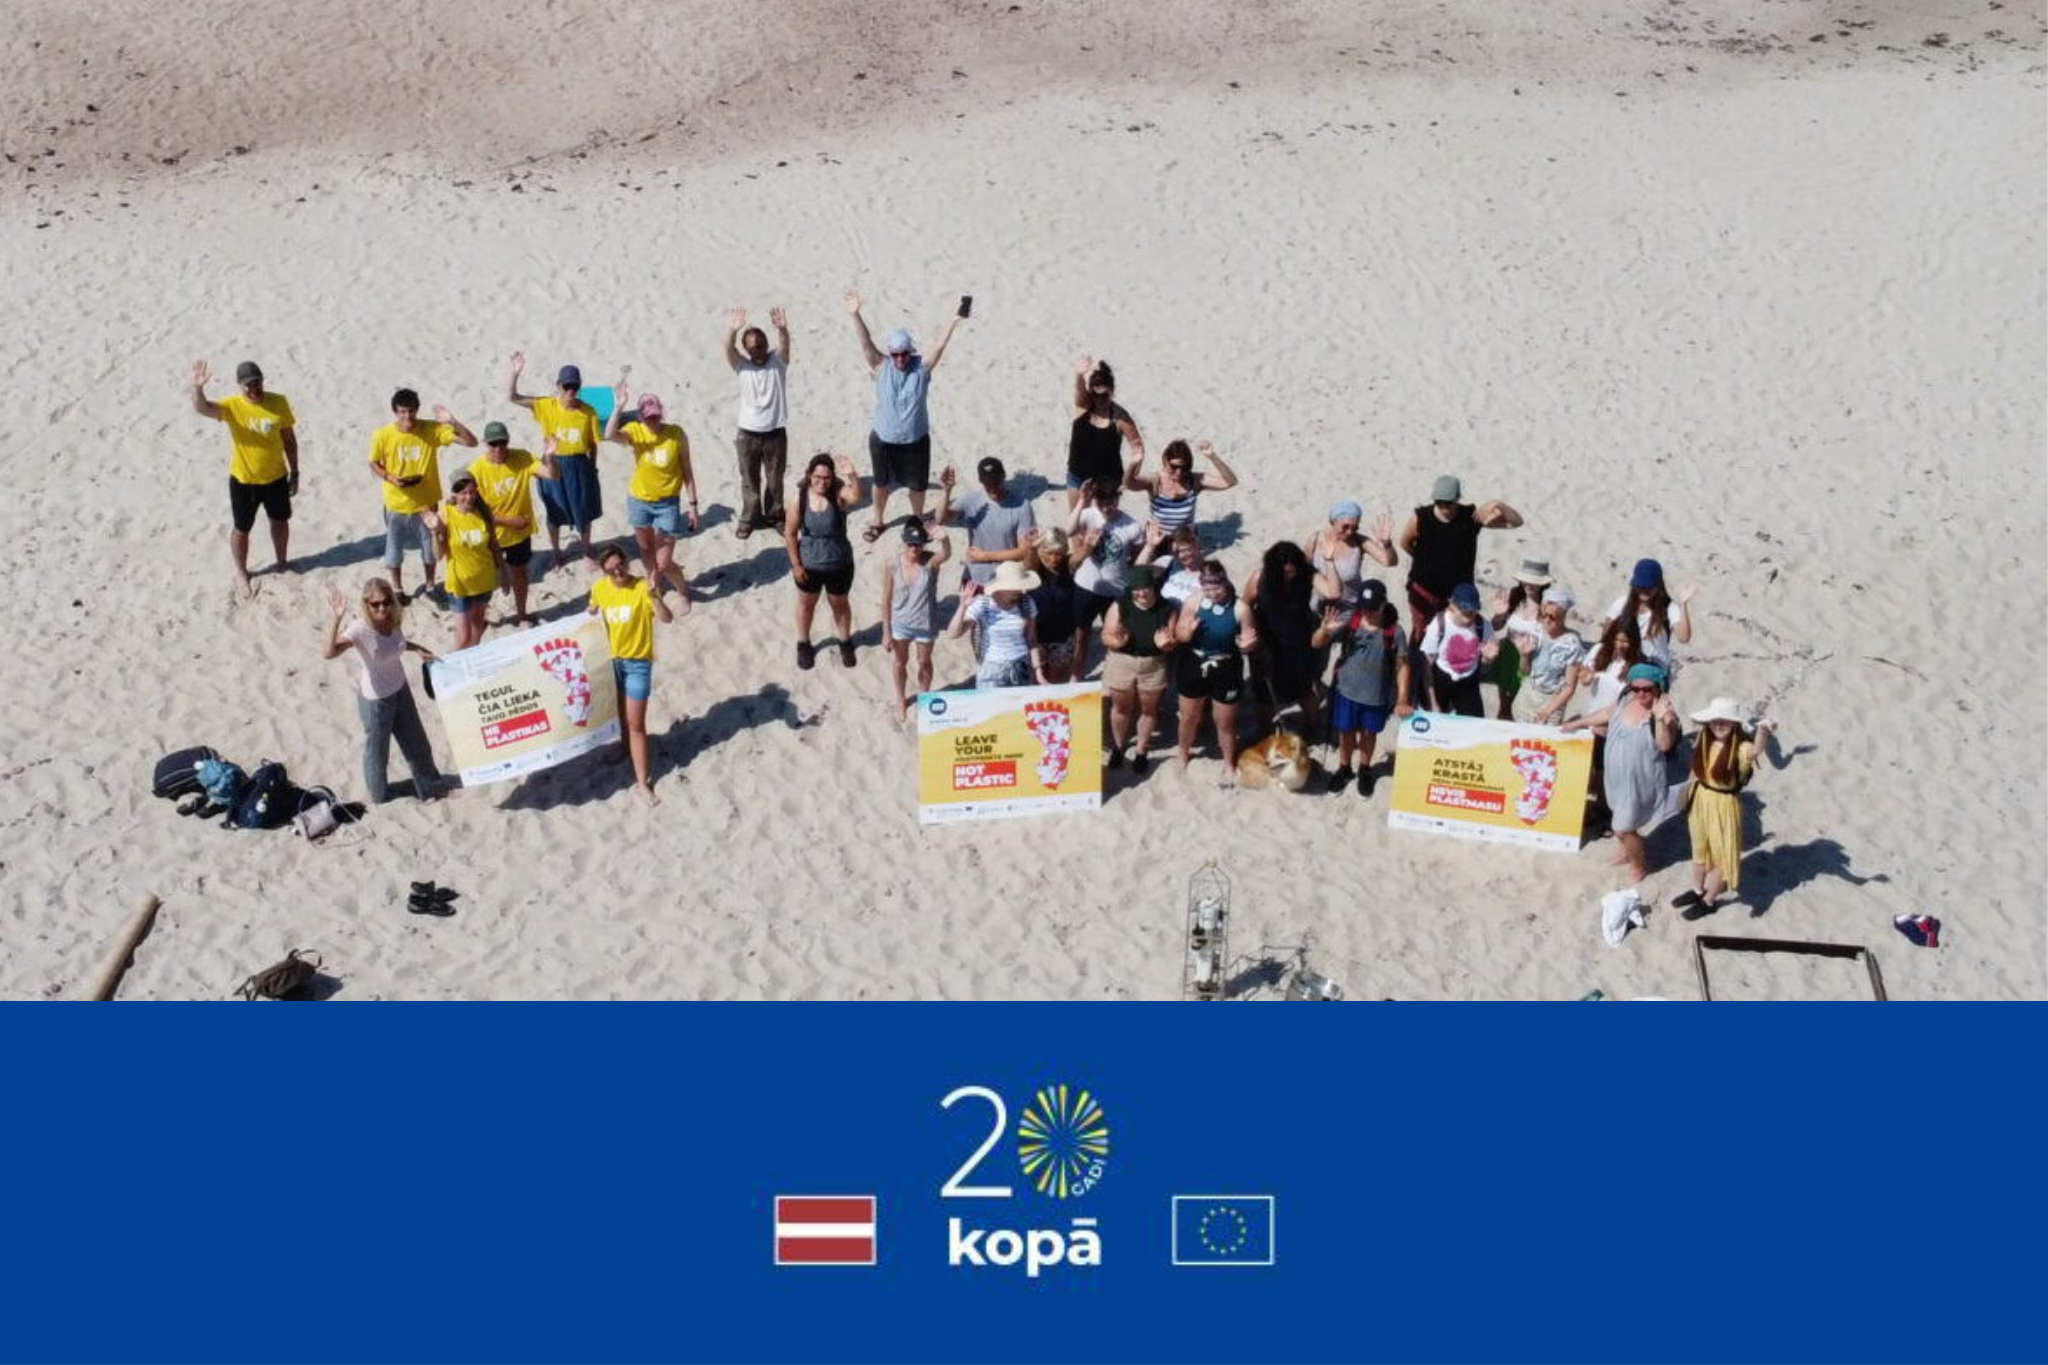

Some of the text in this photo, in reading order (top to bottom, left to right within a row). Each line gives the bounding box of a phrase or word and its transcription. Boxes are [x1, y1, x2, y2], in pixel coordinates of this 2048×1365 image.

[474, 684, 515, 702] TEGUL
[503, 689, 541, 708] LIEKA
[955, 734, 998, 746] LEAVE
[955, 744, 992, 755] YOUR
[955, 764, 985, 776] NOT
[955, 773, 1014, 787] PLASTIC
